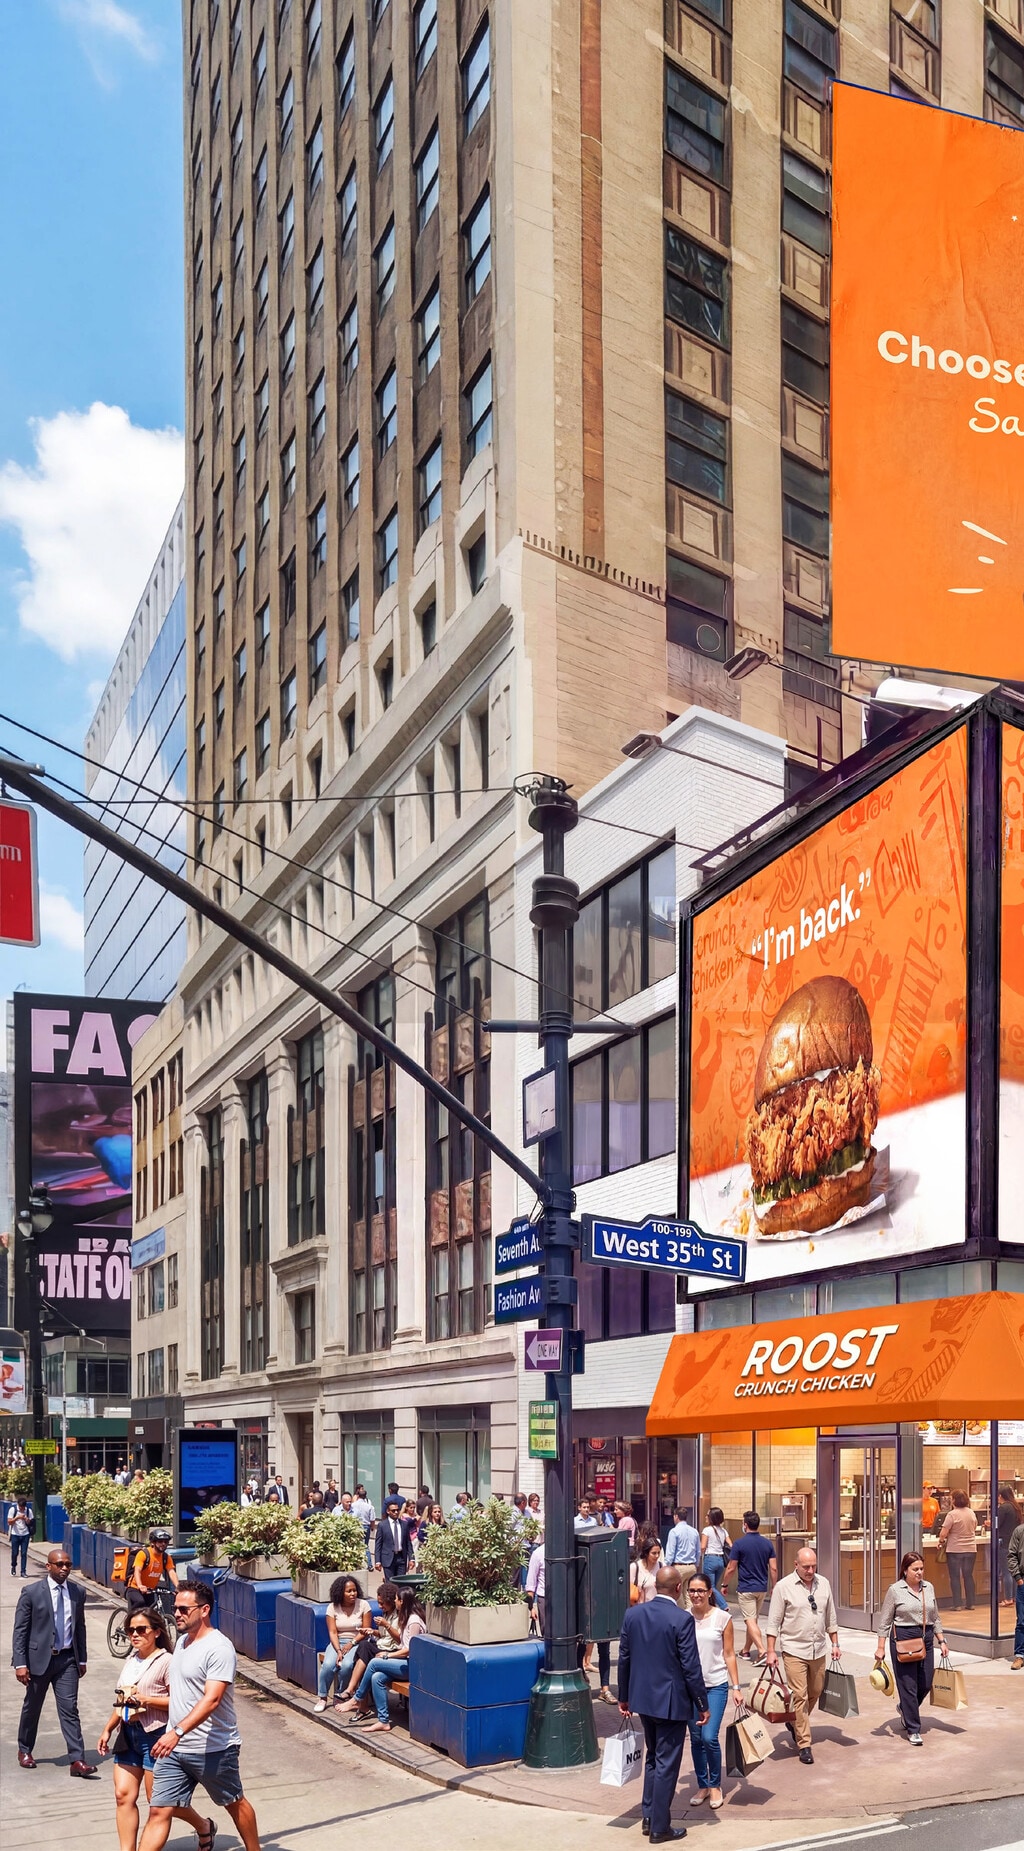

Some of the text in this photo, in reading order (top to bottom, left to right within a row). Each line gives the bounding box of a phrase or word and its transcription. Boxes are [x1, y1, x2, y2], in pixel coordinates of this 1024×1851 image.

[651, 1223, 692, 1238] 100-199
[498, 1236, 529, 1264] Seventh
[602, 1231, 733, 1270] West 35th St
[498, 1289, 527, 1312] Fashion
[537, 1343, 558, 1358] ONE WAY
[741, 1324, 899, 1378] ROOST
[734, 1372, 876, 1398] CRUNCH CHICKEN
